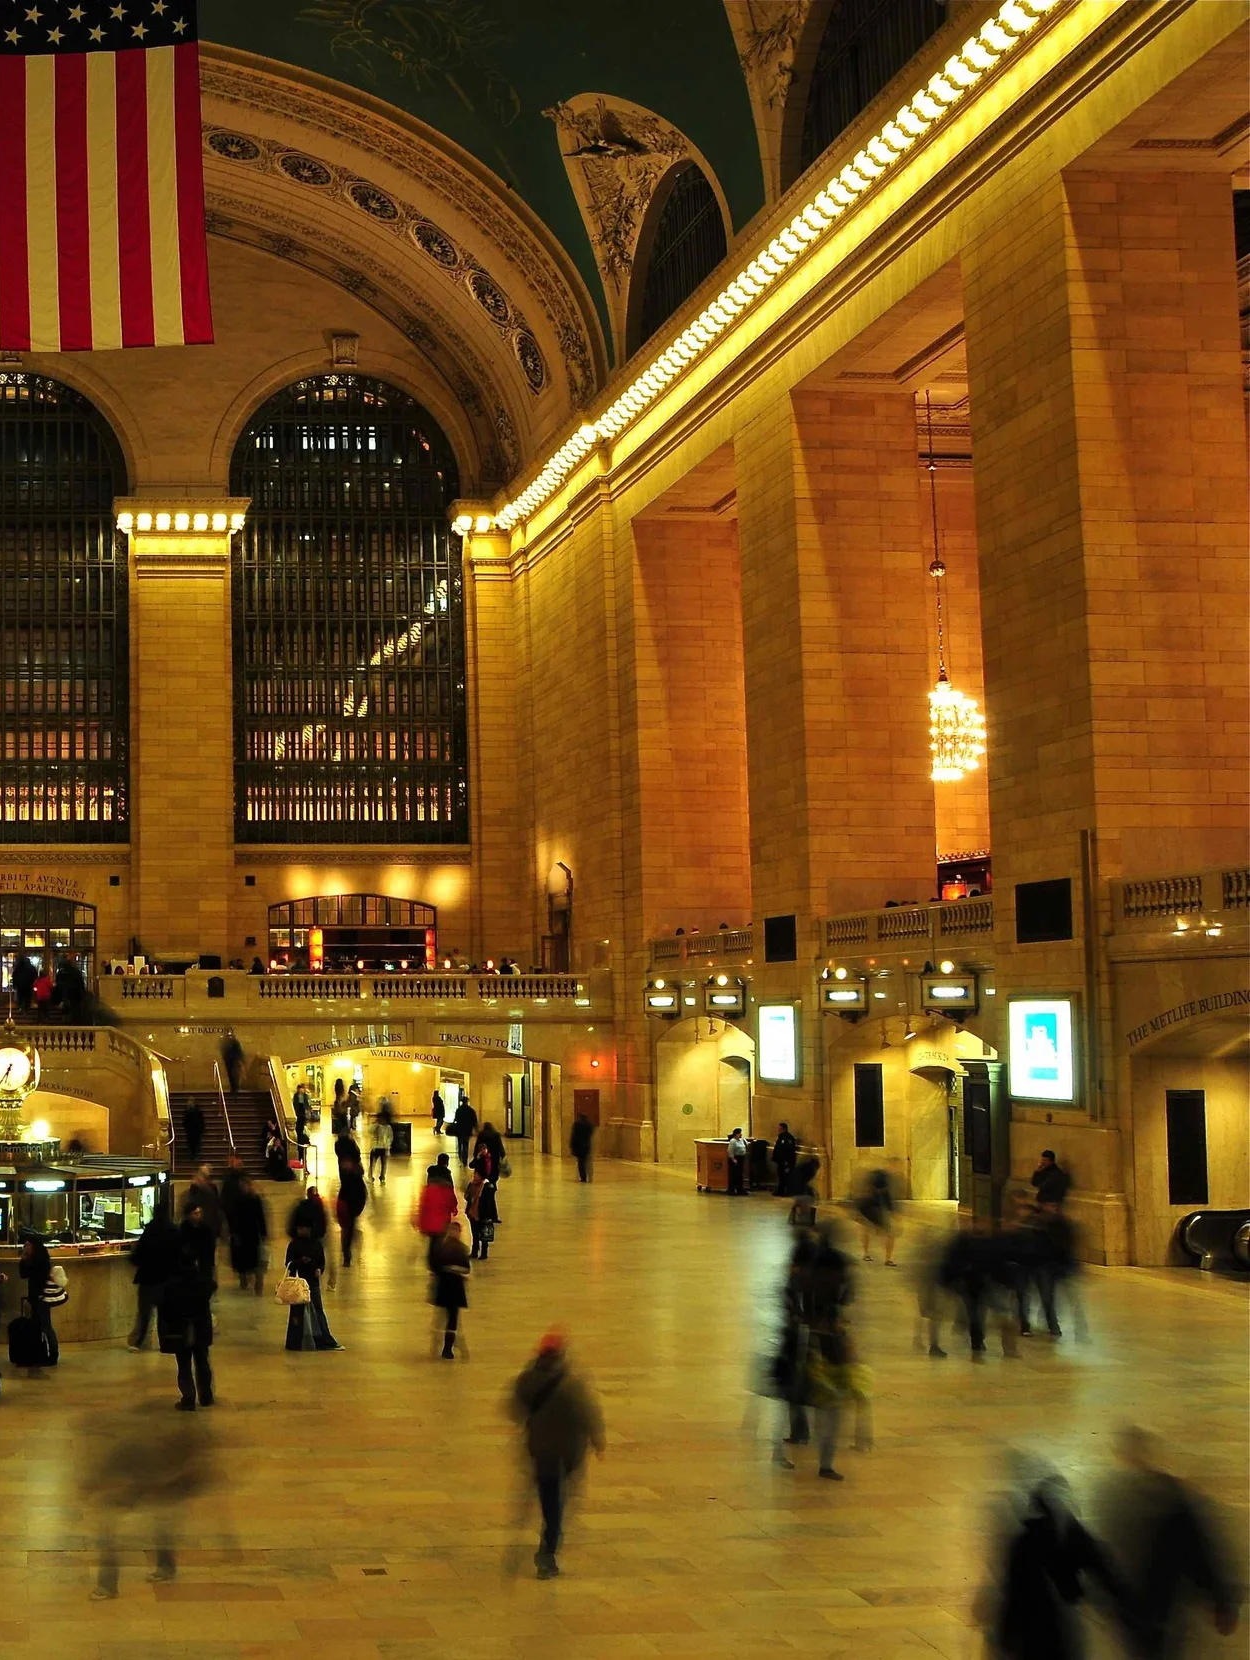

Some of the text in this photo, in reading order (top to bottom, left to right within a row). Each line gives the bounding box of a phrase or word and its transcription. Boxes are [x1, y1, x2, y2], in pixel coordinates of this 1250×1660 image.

[36, 875, 79, 888] AVENUE
[24, 883, 87, 900] APARTMENT
[197, 1026, 234, 1035] BALCONY
[1126, 1024, 1150, 1047] THE
[1149, 1001, 1197, 1034] METLIFE
[305, 1039, 343, 1054] TICKET
[347, 1032, 402, 1047] MACHINES
[438, 1032, 522, 1051] TRACKS 31 TO 42
[370, 1049, 442, 1064] WAITING ROOM
[37, 1082, 61, 1092] RACKS
